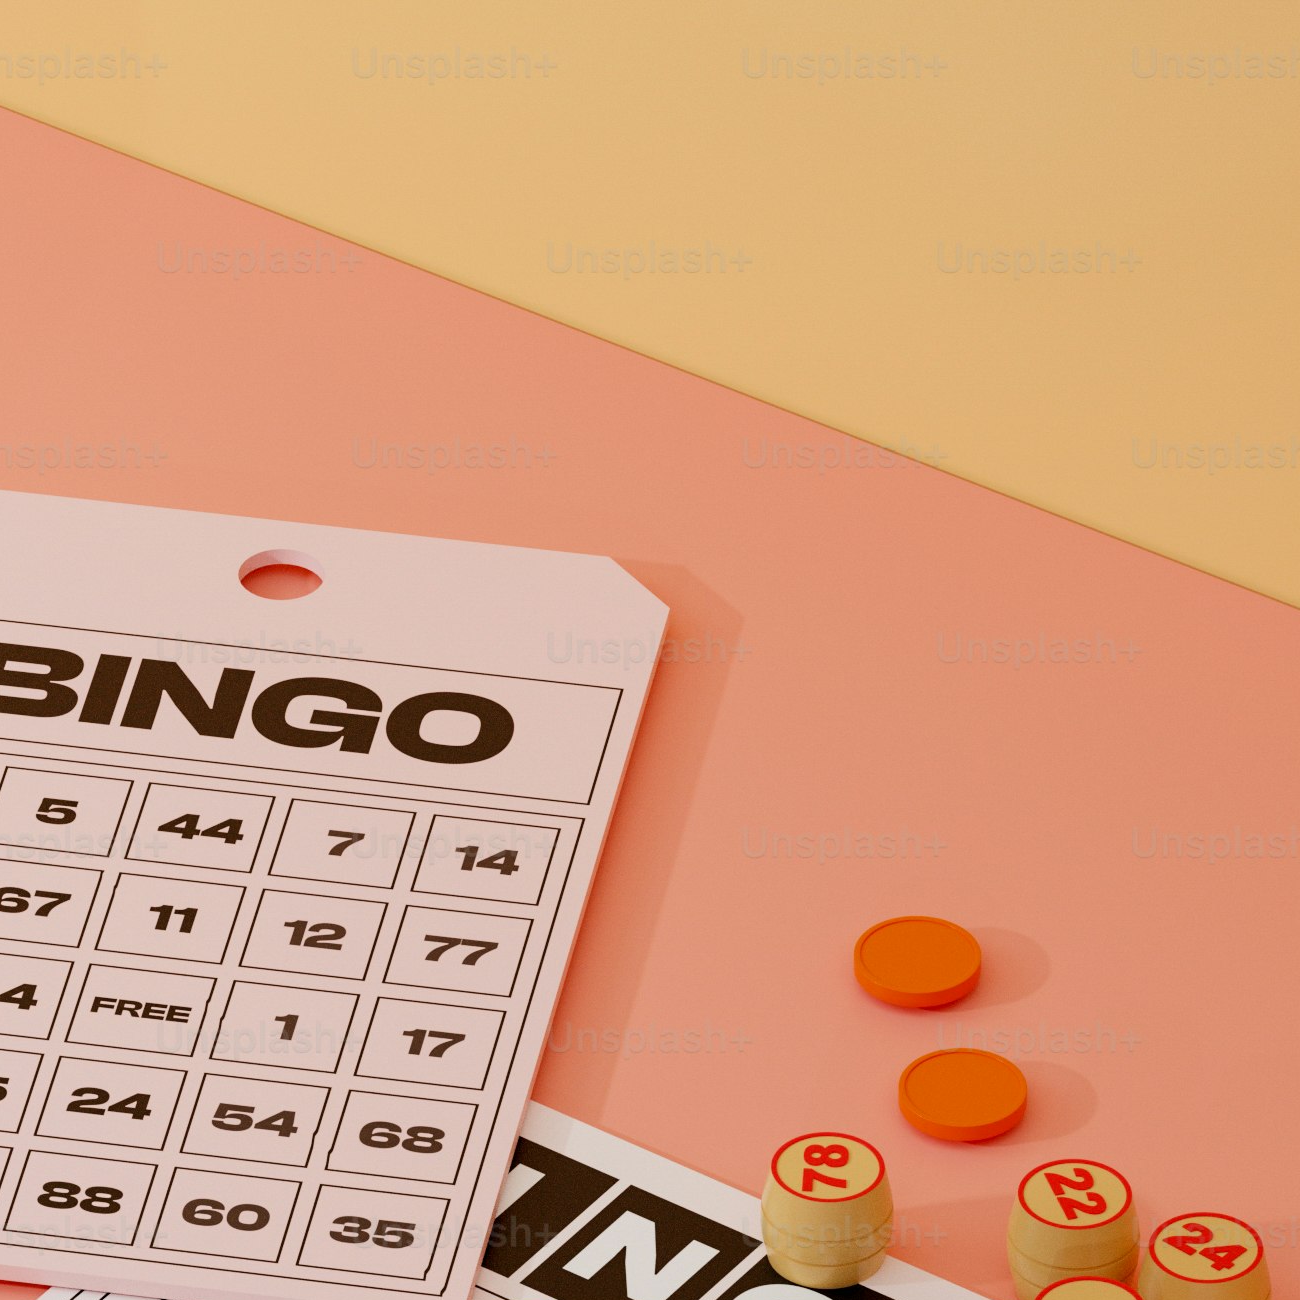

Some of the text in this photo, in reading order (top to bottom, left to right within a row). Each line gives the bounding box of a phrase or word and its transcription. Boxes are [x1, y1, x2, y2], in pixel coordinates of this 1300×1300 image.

[35, 797, 79, 825] 5
[157, 813, 244, 845] 44
[327, 829, 366, 857] 7
[455, 845, 520, 876] 14
[149, 904, 199, 934] 11
[283, 919, 347, 951] 12
[424, 934, 499, 966] 77
[90, 996, 193, 1024] FREE
[274, 1014, 299, 1041] 1
[402, 1028, 466, 1058] 17
[66, 1087, 152, 1121] 24
[211, 1102, 298, 1138] 54
[358, 1121, 446, 1154] 68
[801, 1143, 850, 1193] 78
[1043, 1167, 1108, 1221] 22
[36, 1181, 124, 1215] 88
[182, 1198, 271, 1232] 60
[329, 1215, 416, 1249] 35
[1162, 1222, 1248, 1272] 24
